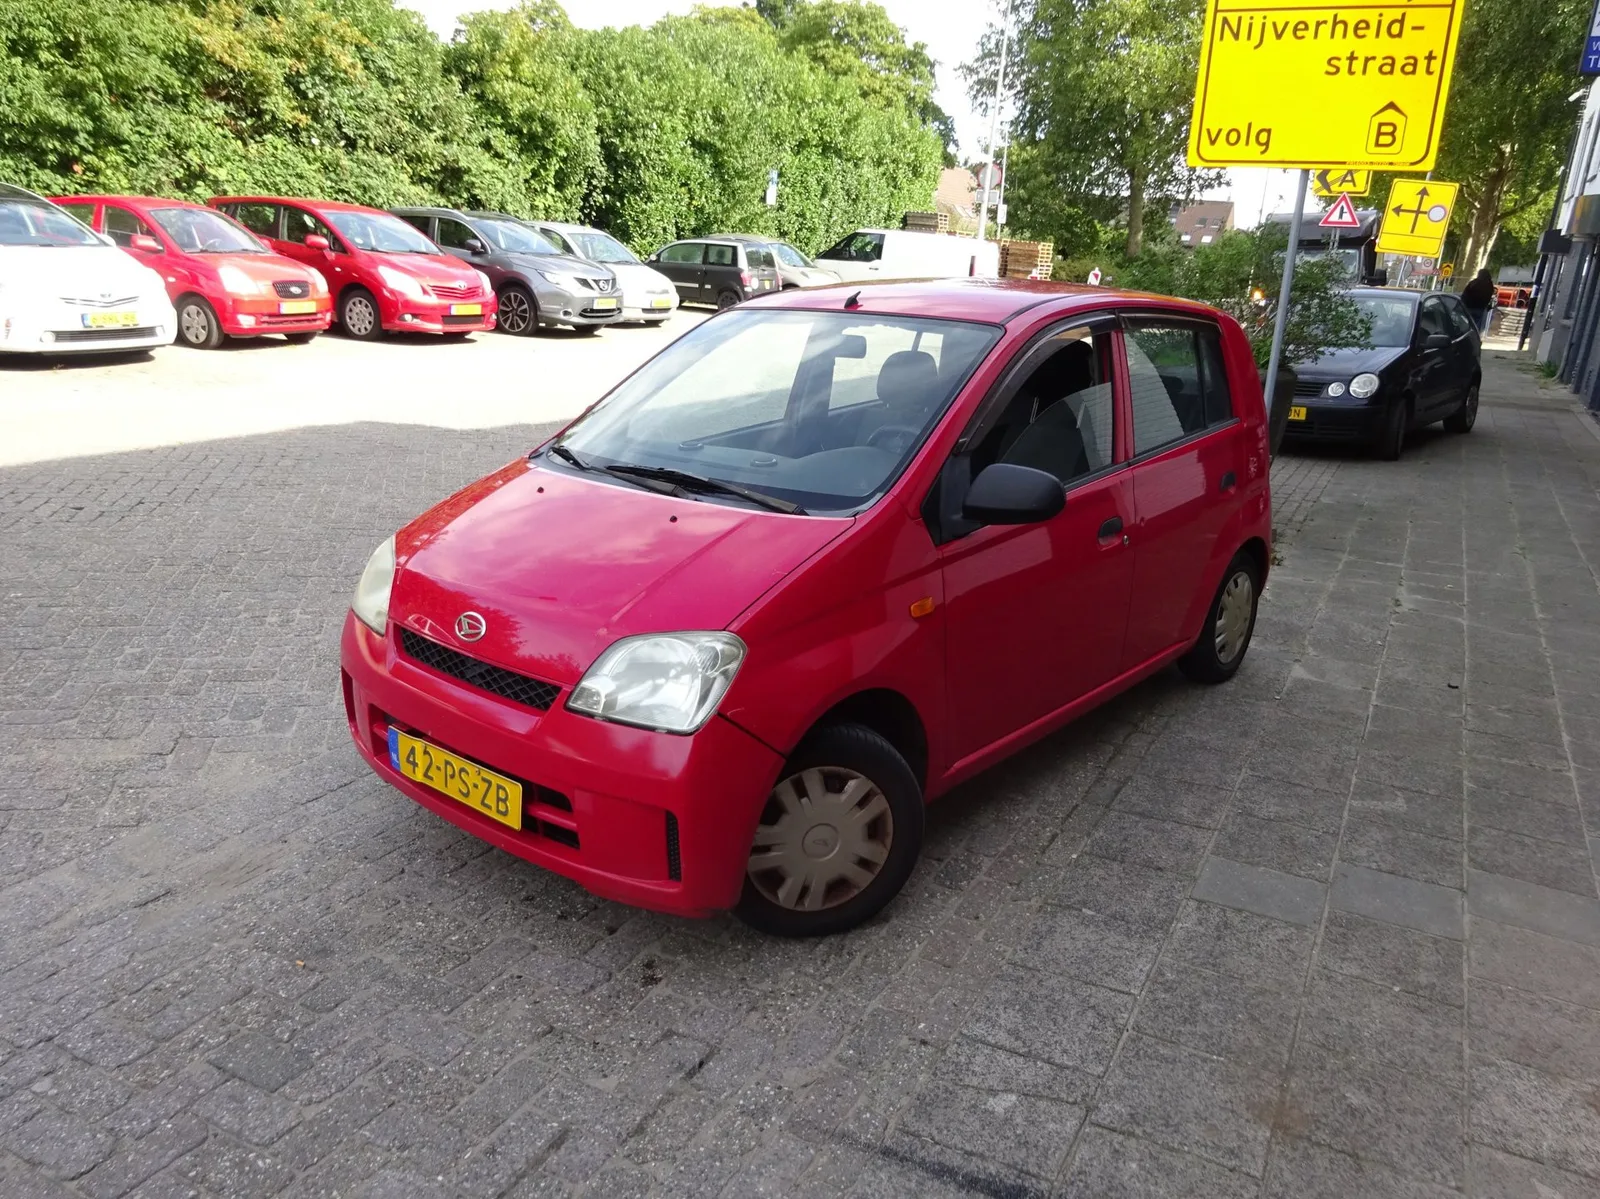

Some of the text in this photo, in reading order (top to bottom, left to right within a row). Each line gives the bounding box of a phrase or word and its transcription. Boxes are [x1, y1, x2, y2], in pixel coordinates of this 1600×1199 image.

[1218, 11, 1426, 50] Nijverheid-
[1323, 49, 1438, 76] straat
[1206, 121, 1273, 156] volg
[1373, 121, 1398, 148] B
[1338, 169, 1357, 188] A
[405, 744, 511, 817] 42-PS-ZB
